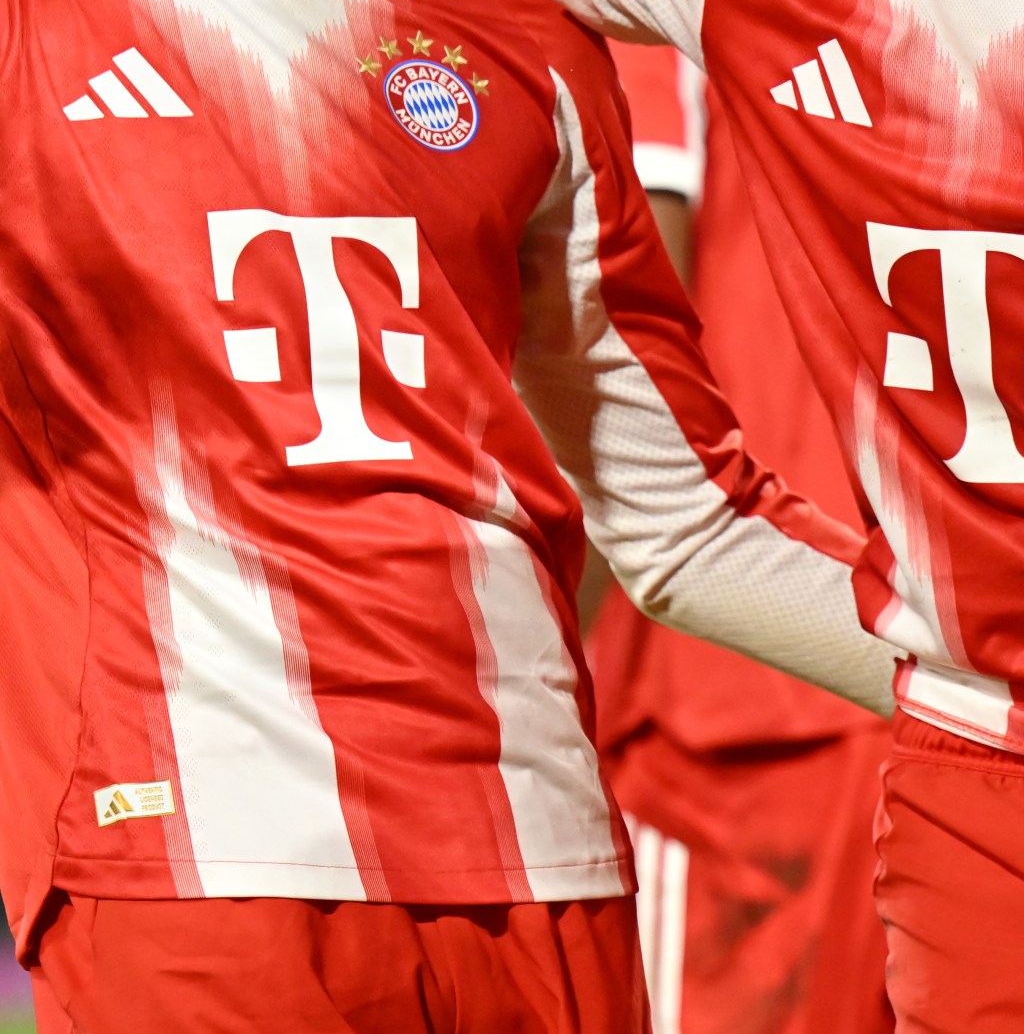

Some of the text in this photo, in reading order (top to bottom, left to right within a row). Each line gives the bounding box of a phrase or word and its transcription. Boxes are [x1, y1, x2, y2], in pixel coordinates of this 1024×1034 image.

[390, 66, 469, 105] FC BAYERN
[395, 109, 471, 146] MÜNCHEN
[206, 208, 426, 467] T
